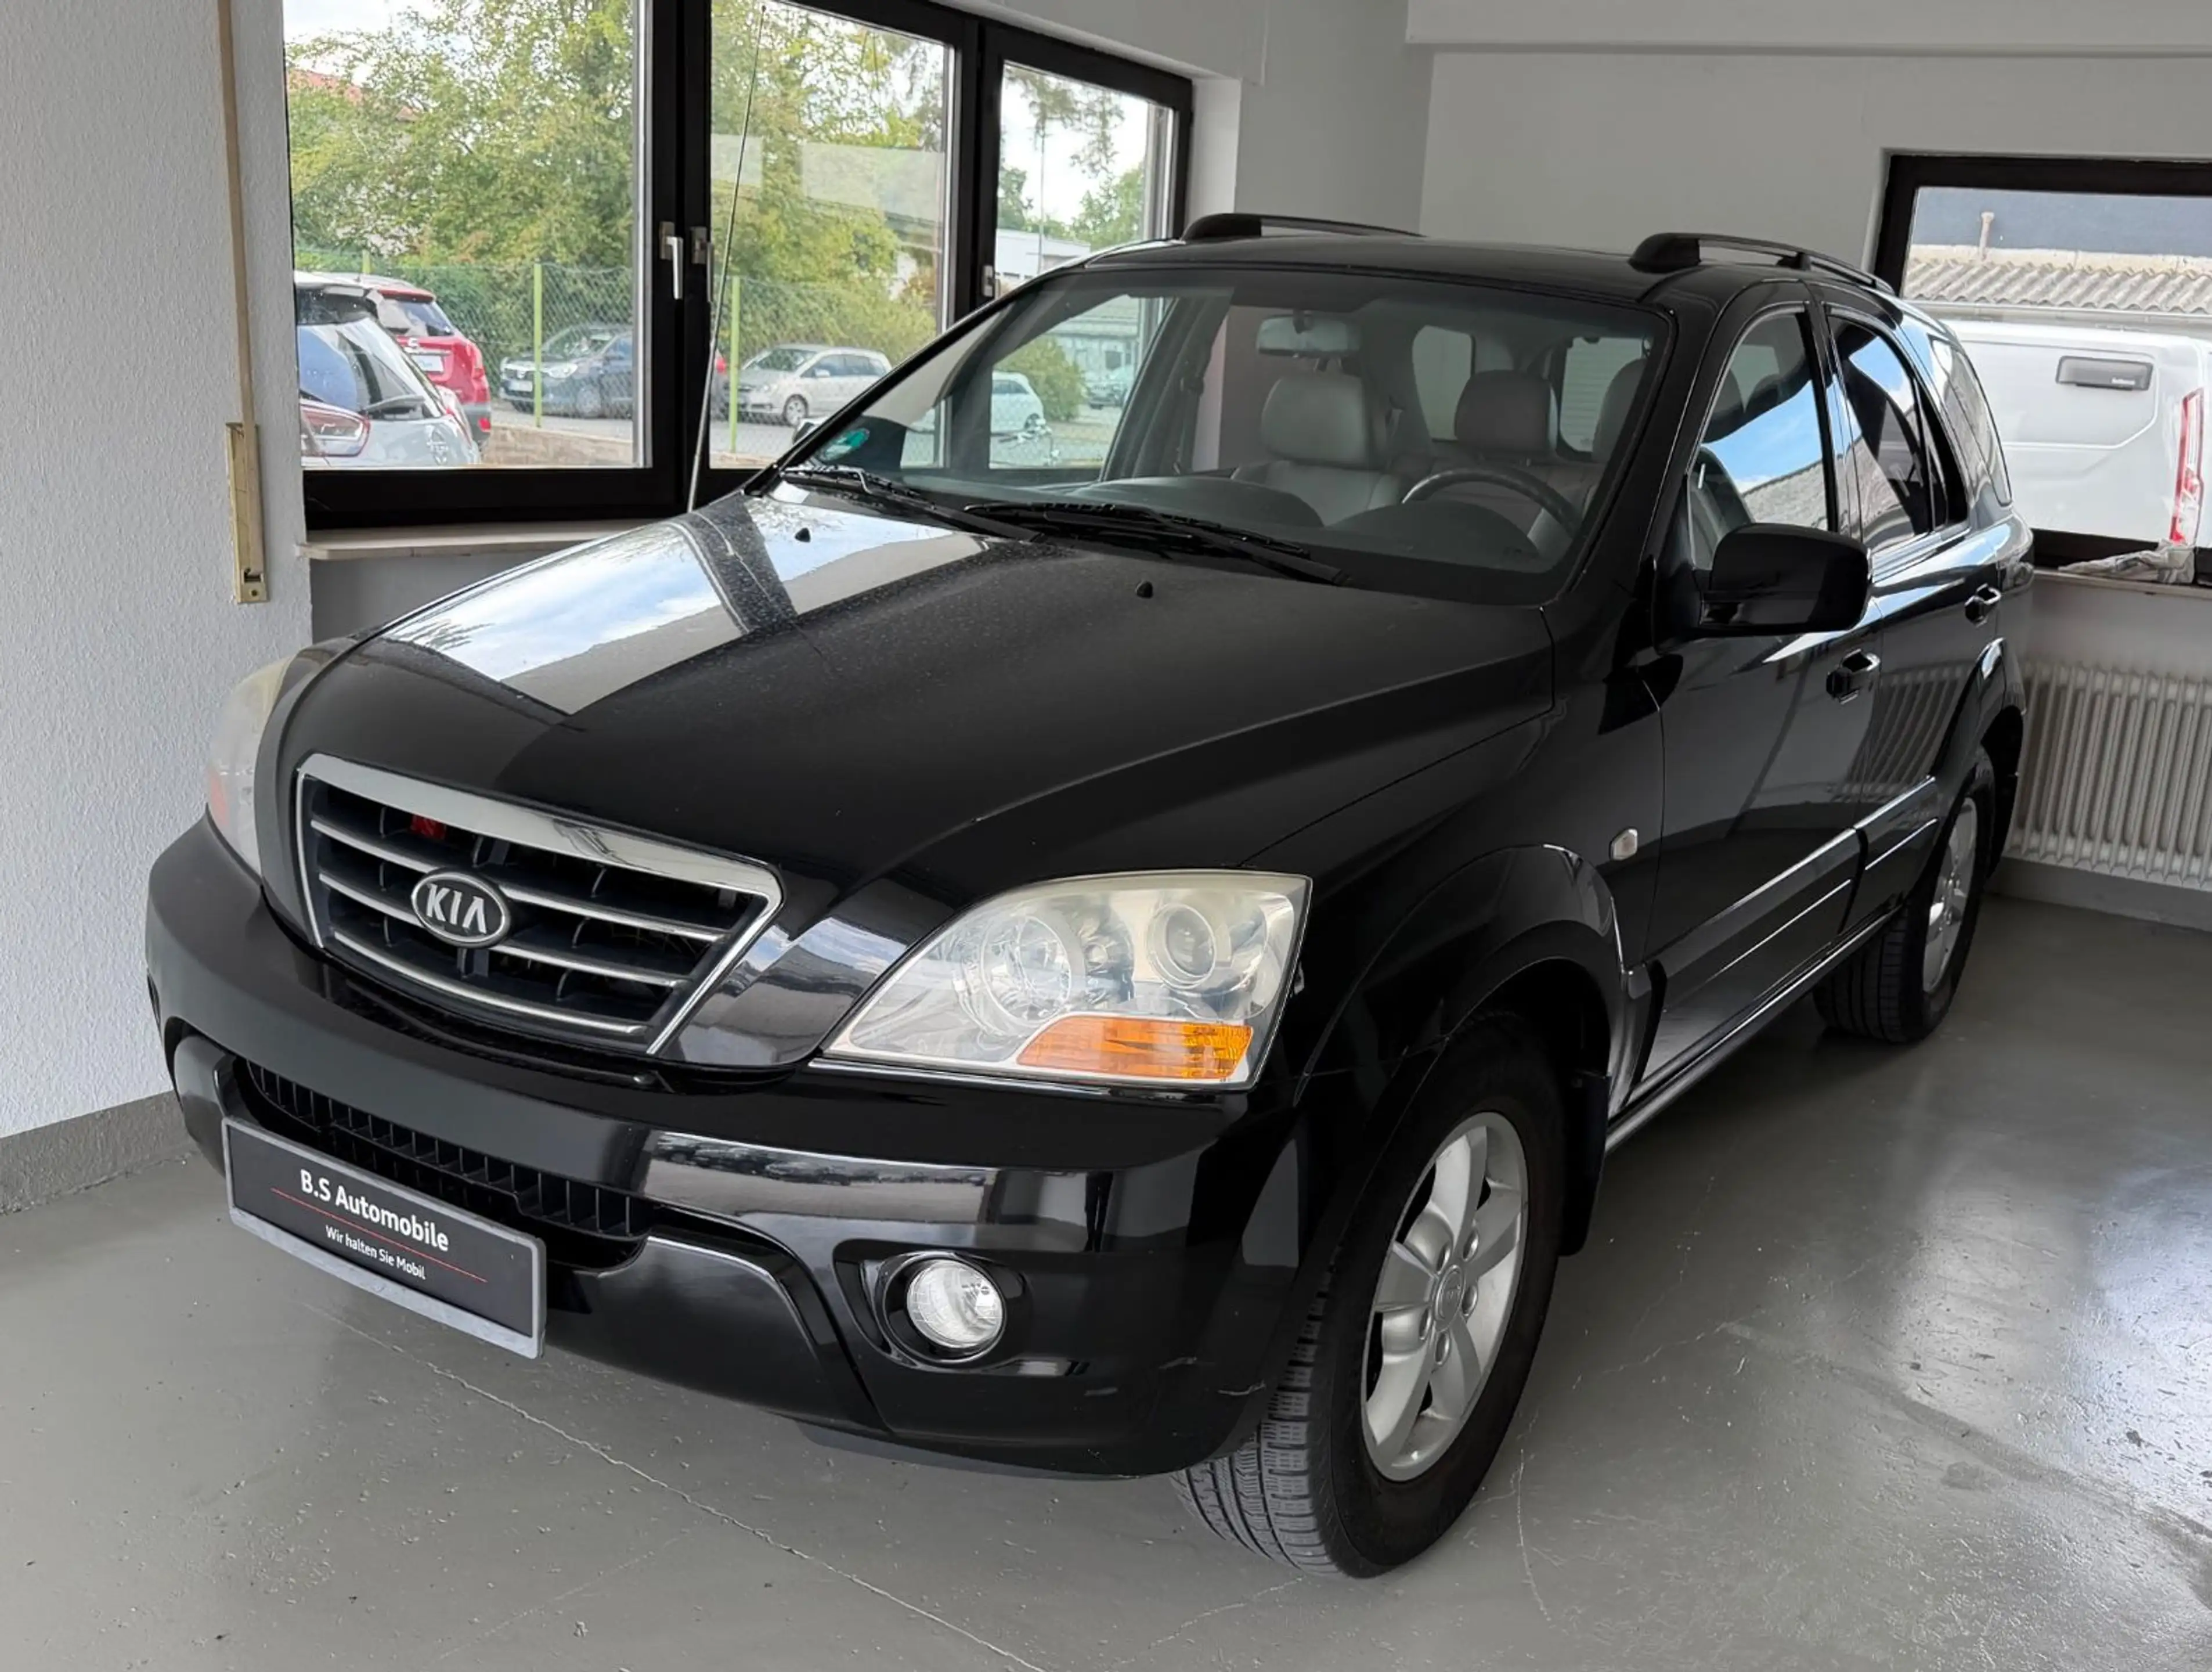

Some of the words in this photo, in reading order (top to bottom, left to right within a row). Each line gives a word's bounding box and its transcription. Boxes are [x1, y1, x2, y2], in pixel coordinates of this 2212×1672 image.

[426, 882, 487, 934] KIA
[300, 1168, 331, 1202] B.S
[335, 1185, 449, 1252] Automobile
[326, 1224, 343, 1244] Wir
[345, 1233, 377, 1259] halten
[378, 1248, 395, 1267] Sie
[396, 1256, 426, 1280] Mobil
